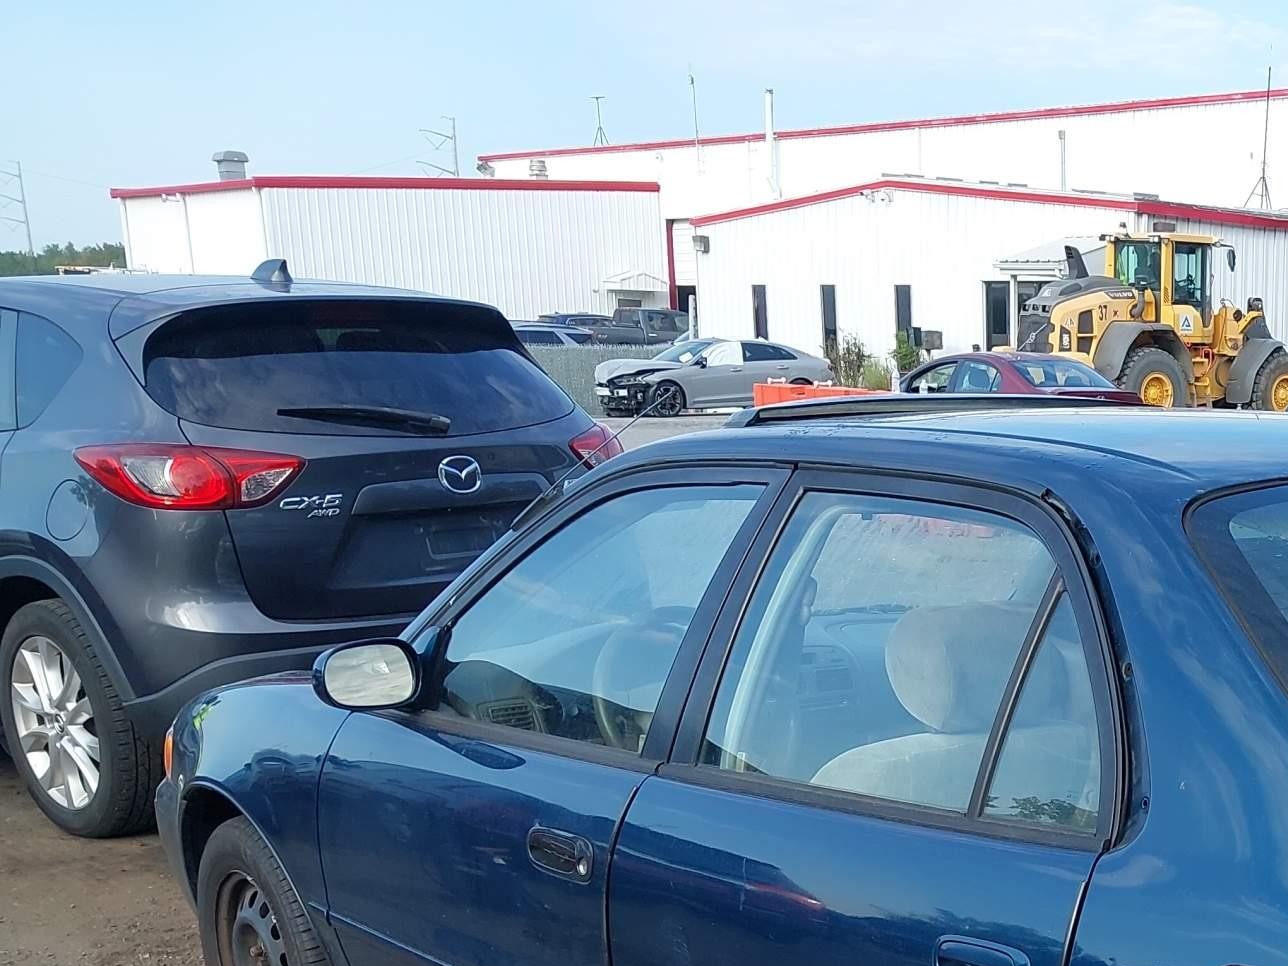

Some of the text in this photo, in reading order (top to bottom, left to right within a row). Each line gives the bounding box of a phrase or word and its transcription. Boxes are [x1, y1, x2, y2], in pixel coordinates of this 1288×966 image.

[1098, 304, 1108, 321] 37
[280, 494, 343, 509] CX-5
[307, 508, 340, 518] AWD
